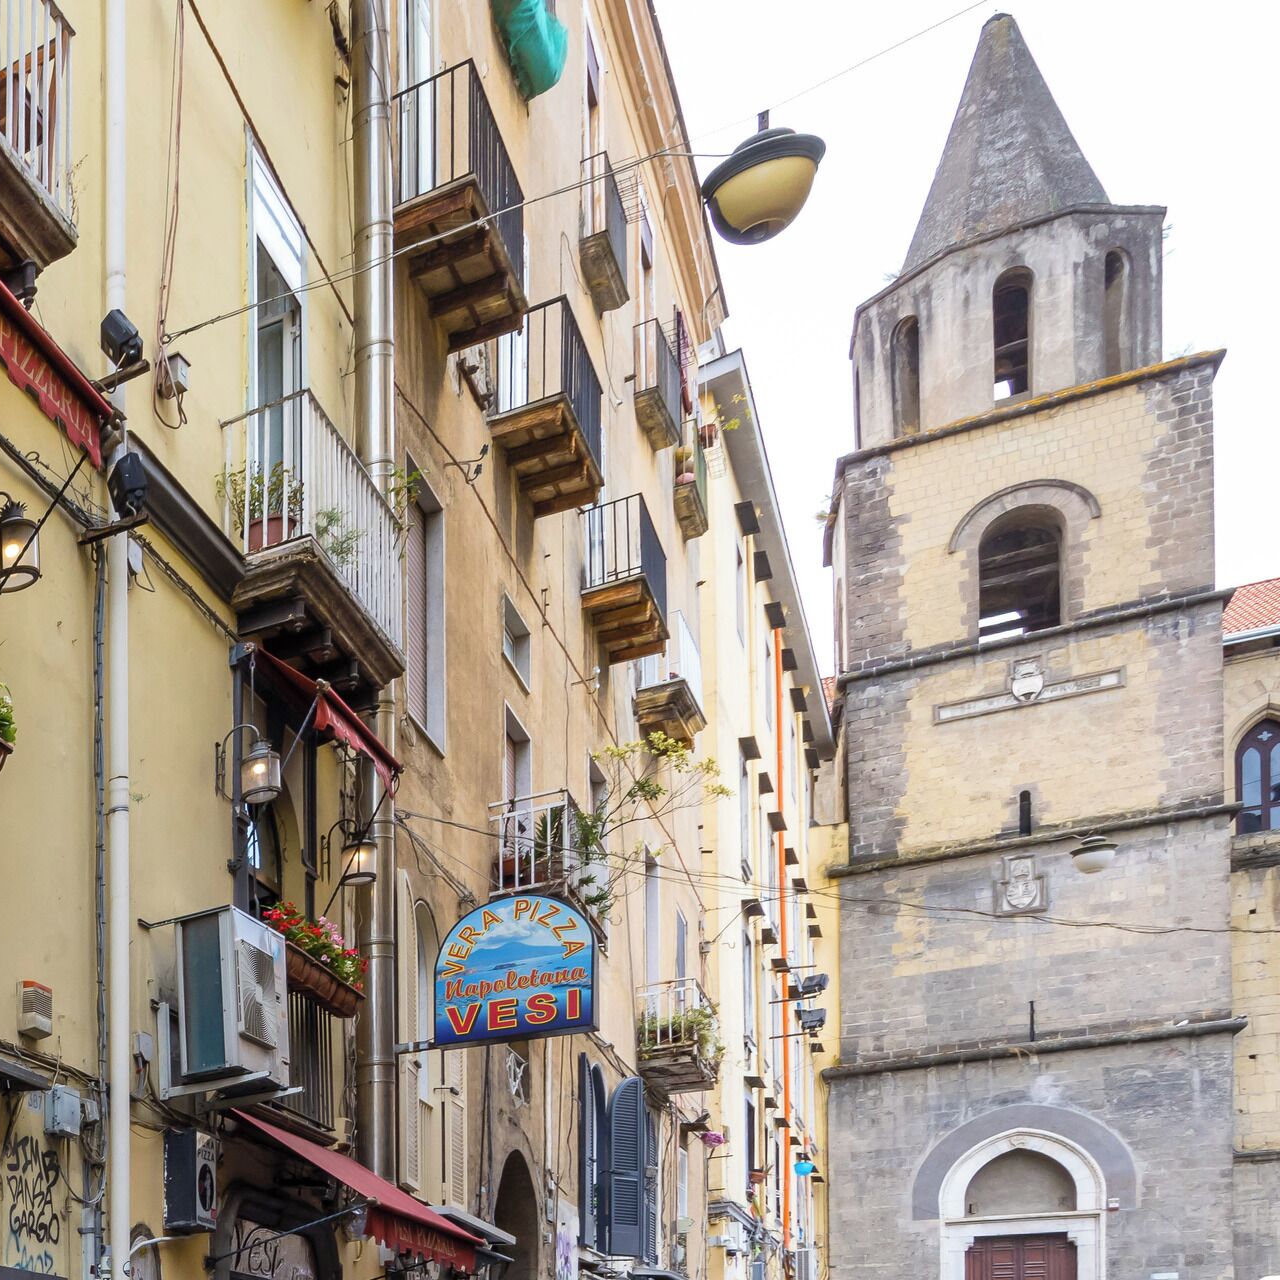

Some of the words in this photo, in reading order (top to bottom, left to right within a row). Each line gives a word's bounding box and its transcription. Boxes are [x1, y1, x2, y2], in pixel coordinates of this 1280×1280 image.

[442, 909, 503, 977] VERA
[514, 900, 585, 959] PIZZA
[445, 967, 588, 1000] Napoletana
[445, 988, 581, 1035] VESI
